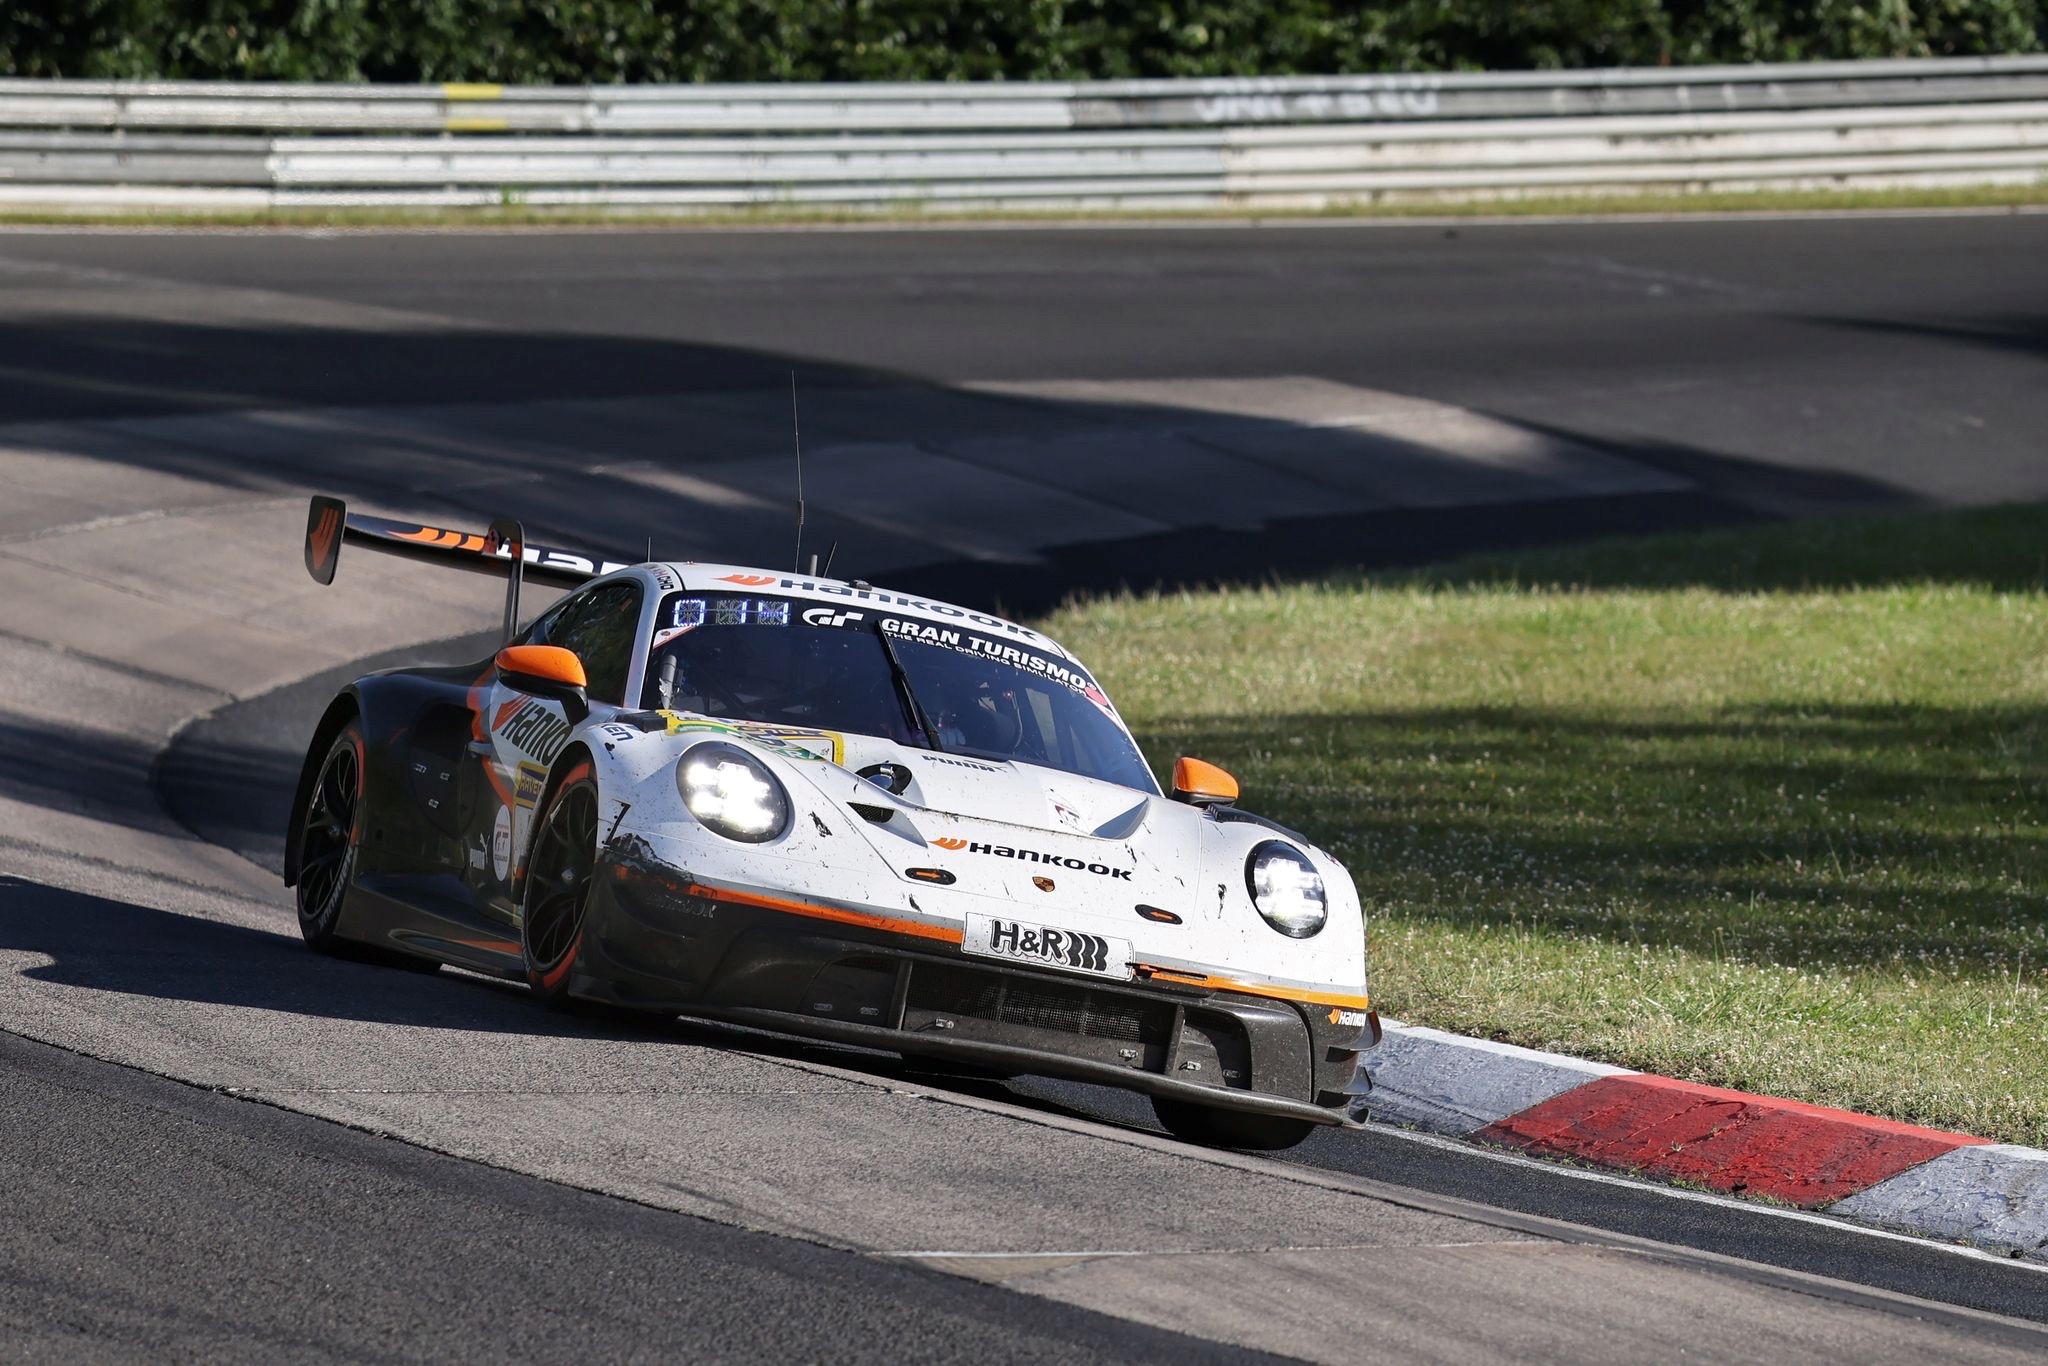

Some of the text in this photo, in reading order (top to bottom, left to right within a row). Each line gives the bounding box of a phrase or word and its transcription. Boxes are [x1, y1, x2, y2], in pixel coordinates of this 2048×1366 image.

[881, 618, 1086, 690] GRAN TURISMO
[885, 631, 1088, 698] THE REAL DRIVING SIMULATOR
[991, 919, 1066, 964] H&R
